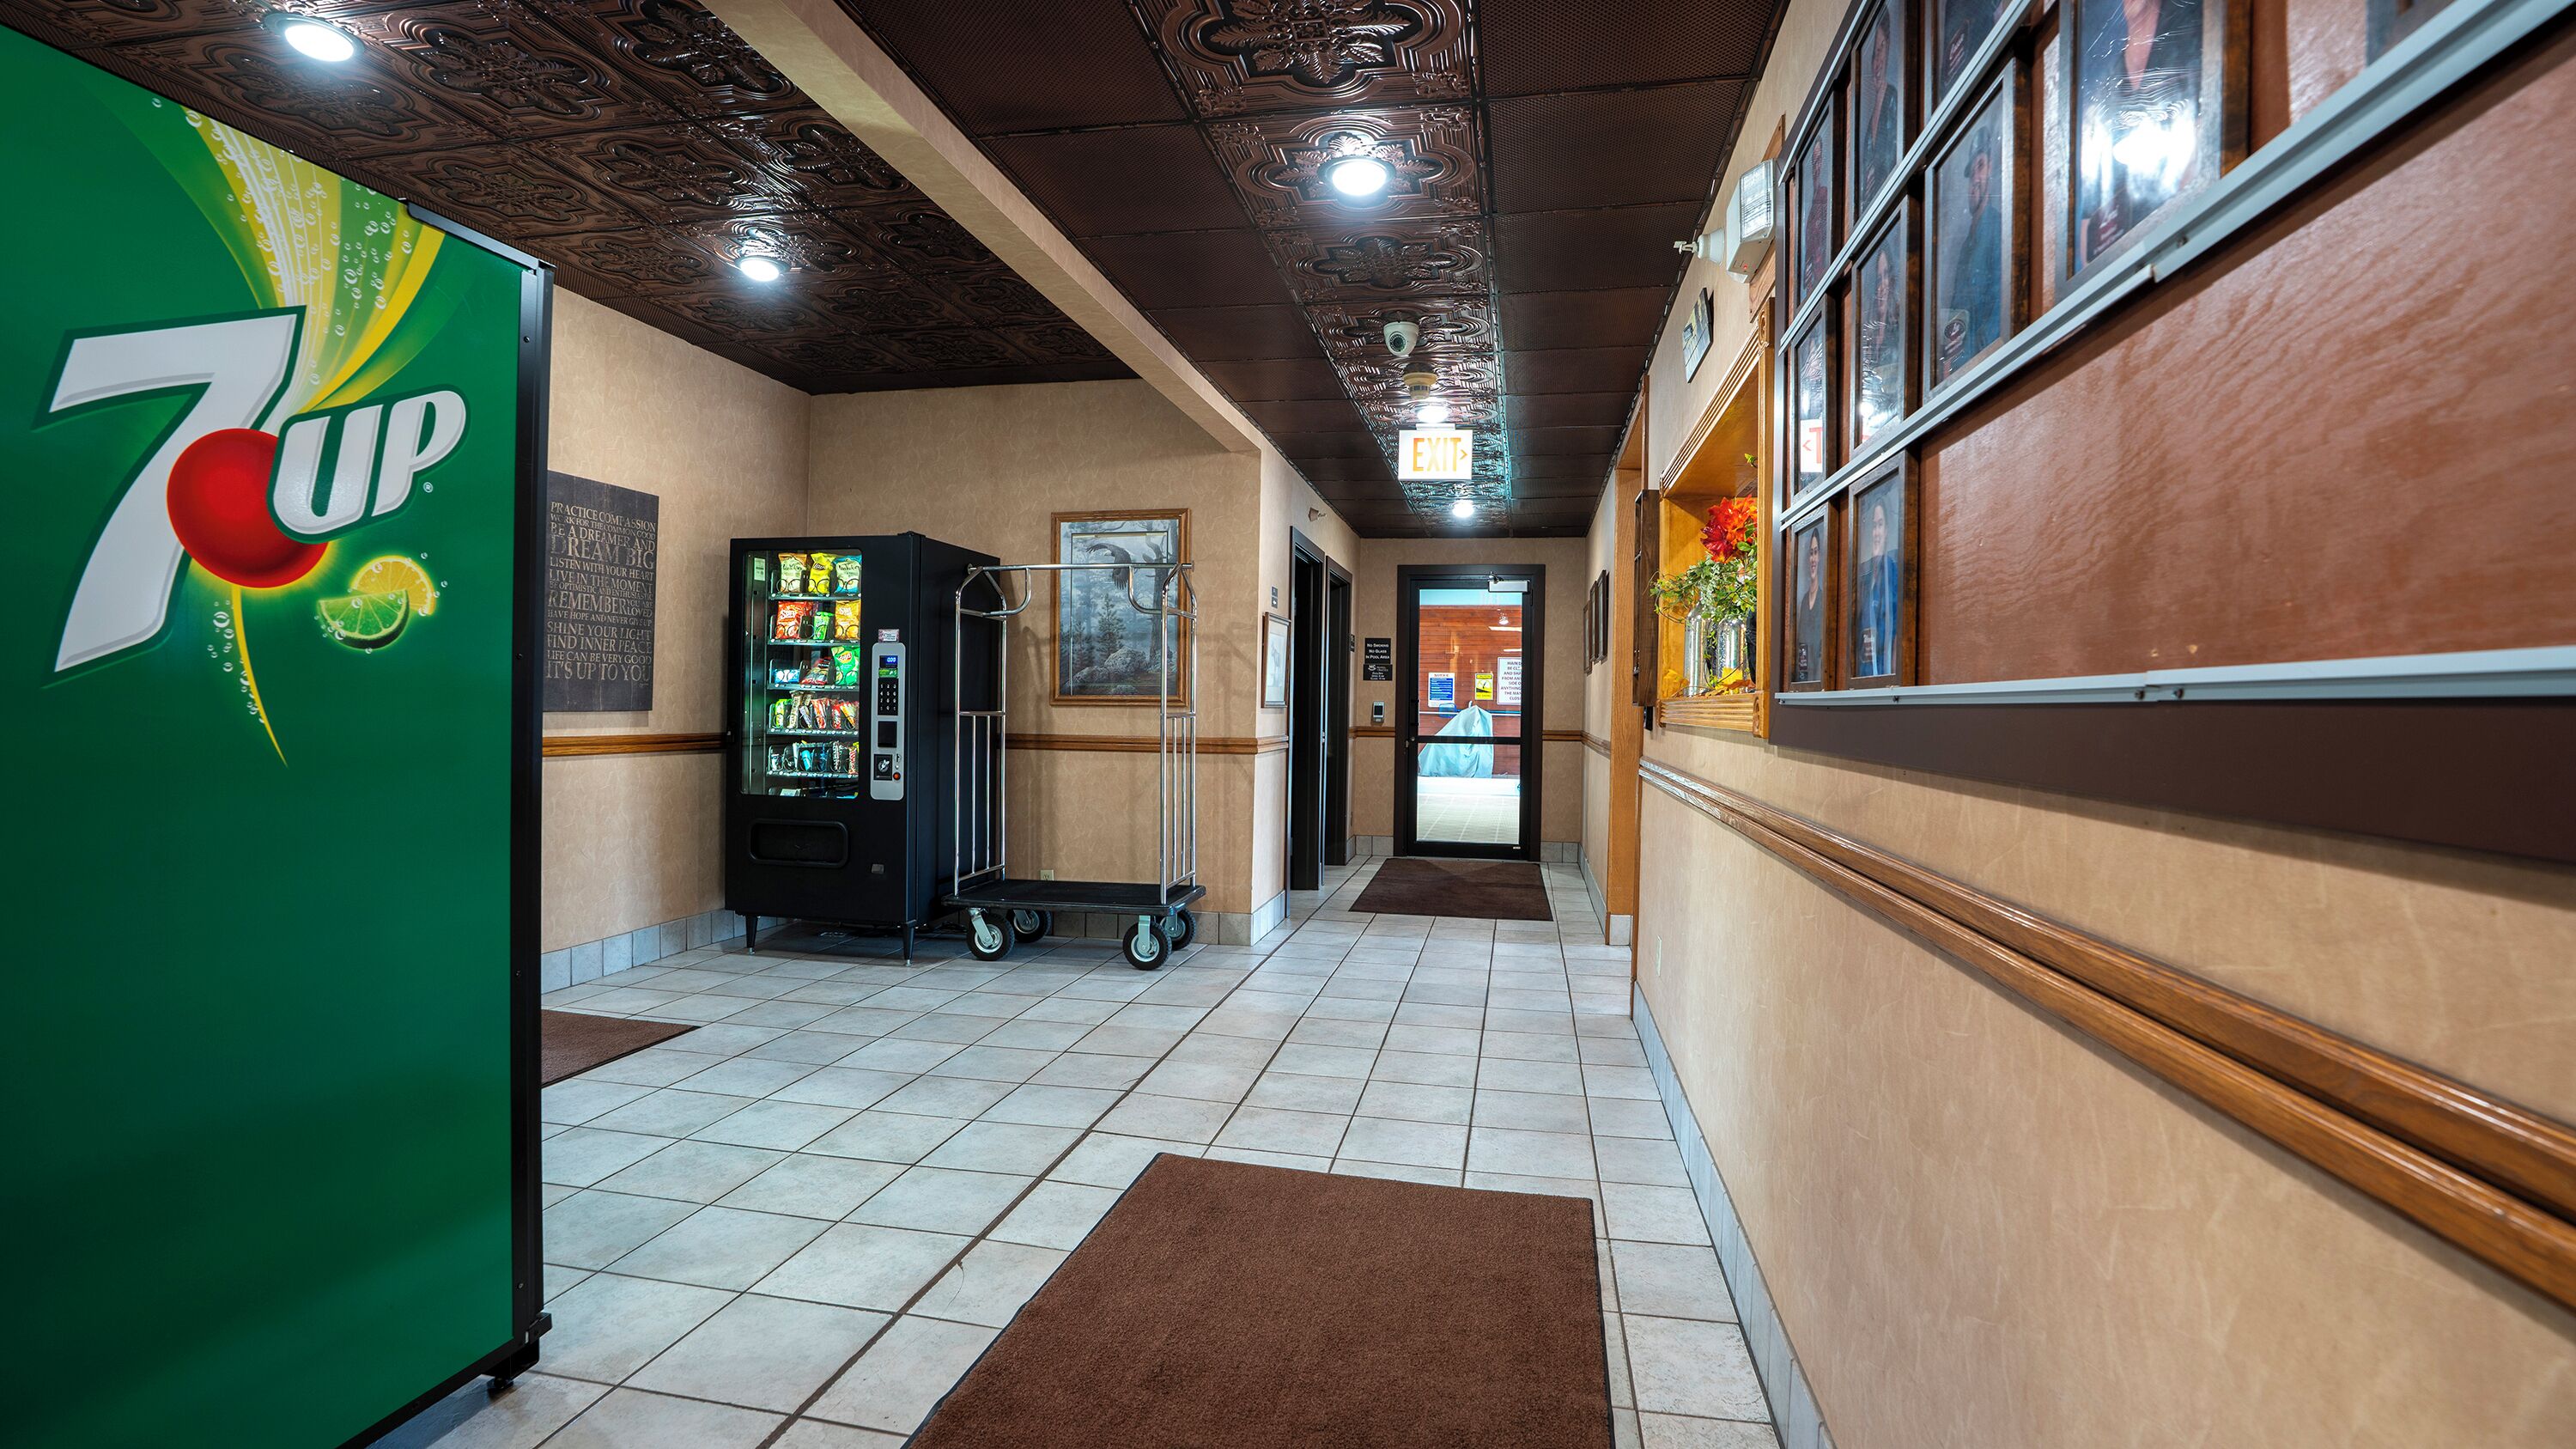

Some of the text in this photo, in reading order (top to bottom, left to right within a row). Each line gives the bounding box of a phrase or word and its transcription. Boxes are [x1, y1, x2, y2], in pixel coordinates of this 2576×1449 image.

[1413, 437, 1461, 472] EXIT
[550, 502, 656, 533] PRACTICE COMPASSION
[550, 514, 655, 540] WORK FOR THE COMMON GOOD
[550, 522, 655, 551] BE A DREAMER AND
[550, 534, 654, 569] DREAM BIG
[550, 557, 654, 581] LISTEN WITH YOUR HEART
[550, 569, 653, 594] LIVE IN THE MOMENT
[559, 582, 598, 593] OPTIMISTIC
[598, 587, 610, 595] AND
[610, 589, 653, 600] ENTHUSIASTIC
[548, 589, 628, 615] REMEMBER
[627, 606, 653, 618] LOVED
[548, 609, 568, 618] HAVE
[569, 611, 589, 620] HOPE
[591, 613, 606, 622] AND
[606, 615, 628, 624] NEVER
[547, 621, 652, 641] SHINE YOUR LIGHT
[547, 634, 652, 654] FIND INNER PEACE
[547, 649, 652, 665] LIFE CAN BE VERY GOOD
[546, 661, 652, 681] IT'S UP TO YOU
